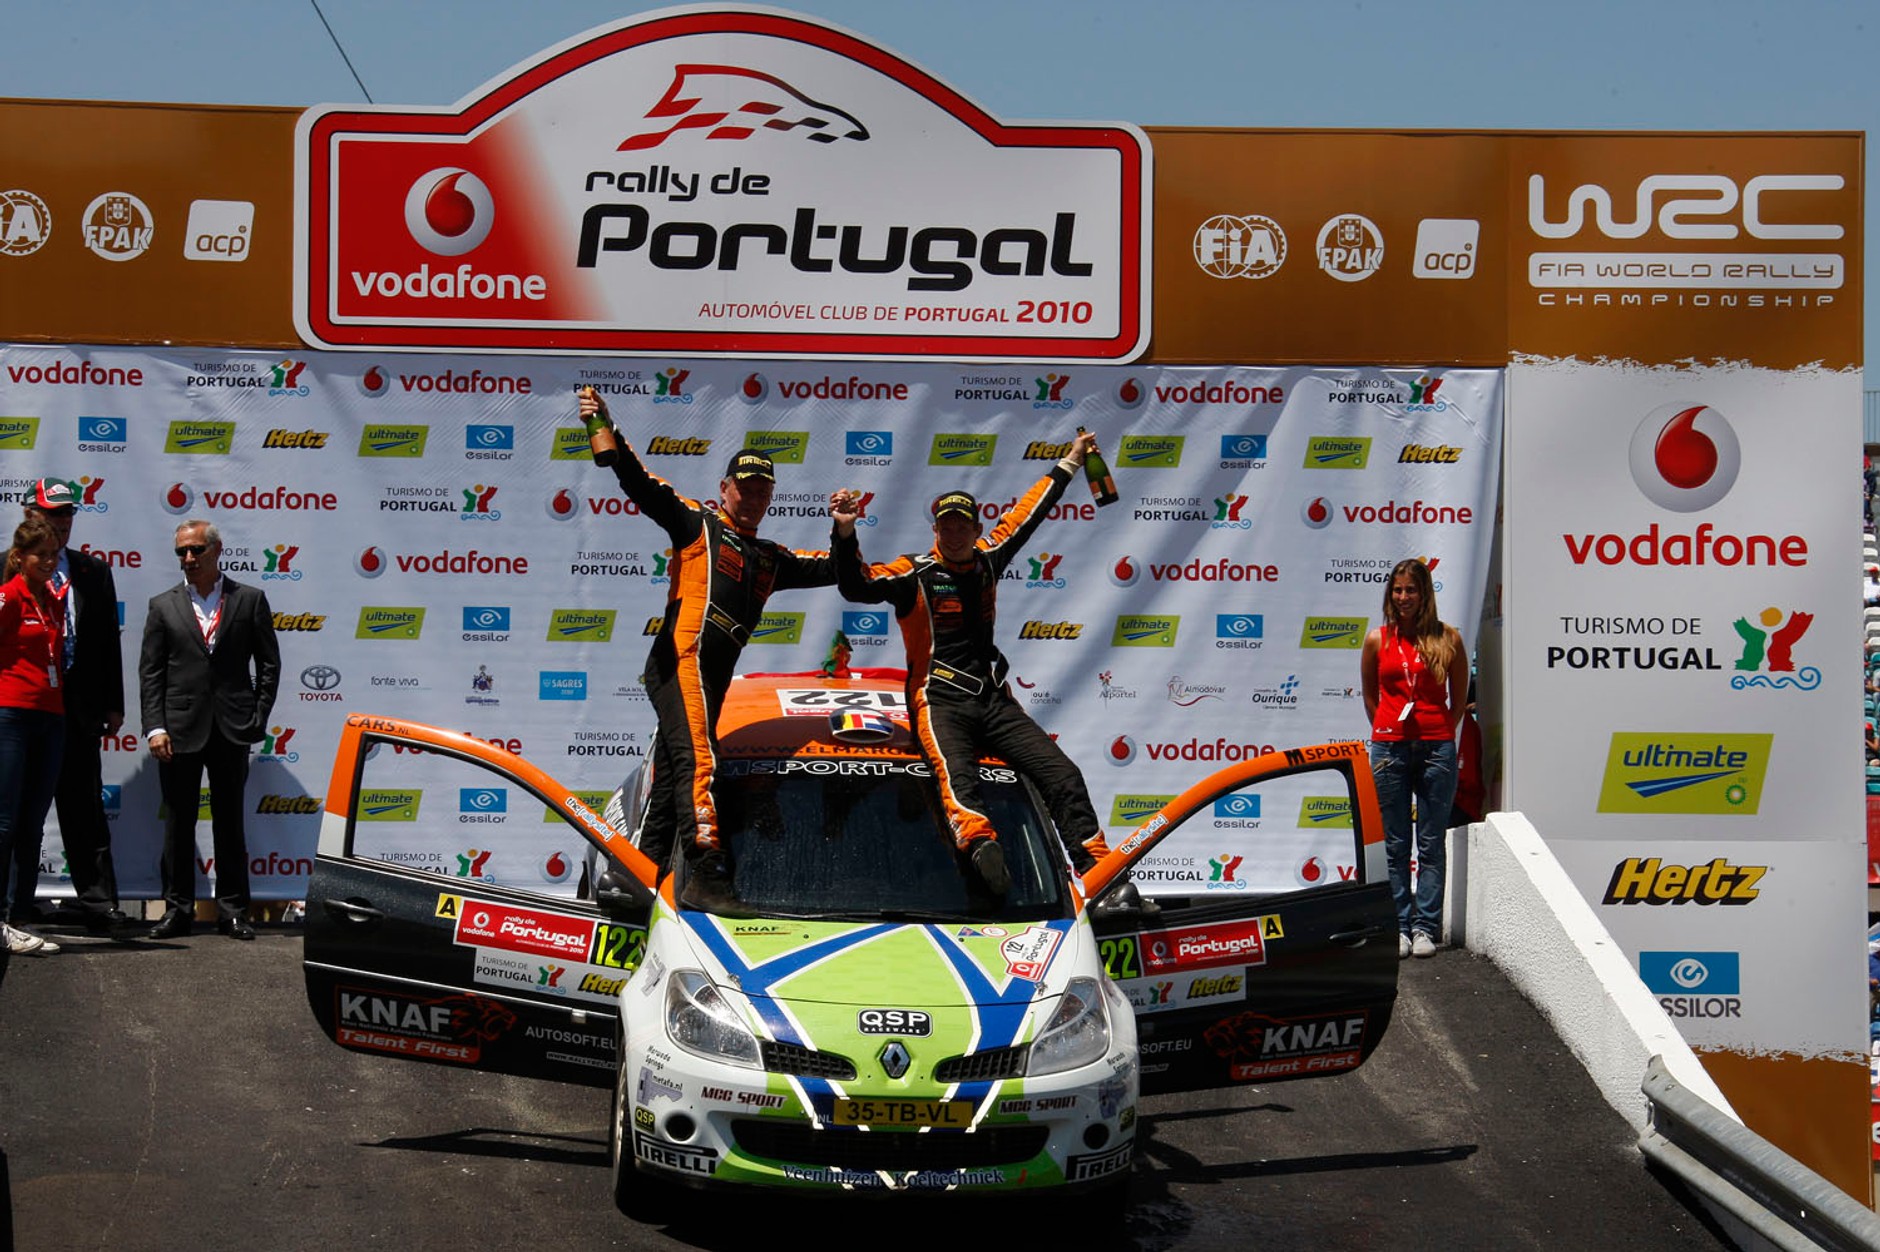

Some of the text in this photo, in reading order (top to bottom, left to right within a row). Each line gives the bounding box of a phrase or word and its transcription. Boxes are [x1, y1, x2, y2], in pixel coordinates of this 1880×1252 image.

[585, 165, 770, 202] rally de
[1529, 174, 1845, 239] WRC
[85, 225, 152, 250] FPAK
[196, 234, 246, 256] acp
[577, 203, 1093, 292] Portugal
[1319, 247, 1382, 270] FPAK
[1424, 253, 1472, 274] acp
[1539, 264, 1834, 278] FIA WORLD RALLY
[352, 264, 547, 300] vodafone
[1539, 294, 1834, 306] CHAMPIONSHIP
[699, 300, 1093, 324] AUTOMÓVEL CLUB DE PORTUGAL 2010
[8, 361, 143, 386] vodafone
[194, 363, 257, 374] TURISMO DE
[580, 370, 642, 380] TURISMO DE
[187, 376, 265, 388] PORTUGAL
[400, 370, 532, 394] vodafone
[962, 377, 1022, 386] TURISMO DE
[1335, 380, 1395, 389] TURISMO DE
[779, 376, 908, 400] vodafone
[1156, 381, 1283, 404] vodafone
[955, 389, 1030, 400] PORTUGAL
[1329, 392, 1404, 404] PORTUGAL
[175, 425, 226, 436] ultimate
[368, 429, 419, 440] ultimate
[262, 428, 329, 449] Hertz
[750, 436, 800, 446] ultimate
[938, 438, 988, 449] ultimate
[78, 443, 127, 453] essilor
[647, 436, 712, 456] Hertz
[1022, 440, 1072, 460] Hert
[1126, 440, 1176, 450] ultimate
[1313, 441, 1363, 451] ultimate
[465, 451, 513, 461] essilor
[1398, 444, 1464, 463] Hertz
[845, 457, 892, 466] essilor
[1220, 461, 1267, 470] essilor
[204, 486, 337, 510] vodafone
[386, 488, 449, 497] TURISMO DE
[813, 494, 826, 503] DE
[380, 501, 457, 512] PORTUGAL
[1141, 497, 1201, 506] TURISMO DE
[1134, 510, 1209, 521] PORTUGAL
[1343, 501, 1472, 523] vodafone
[1563, 523, 1808, 567] vodafone
[396, 550, 528, 574] vodafone
[577, 552, 639, 561] TURISMO DE
[571, 564, 647, 576] PORTUGAL
[1331, 559, 1392, 569] TURISMO DE
[1150, 559, 1279, 582] vodafone
[1325, 572, 1391, 583] PORTUGA
[366, 611, 416, 622] ultimate
[557, 614, 606, 625] ultimate
[1121, 619, 1171, 629] ultimate
[1309, 622, 1359, 632] ultimate
[1560, 617, 1701, 635] TURISMO DE
[1019, 621, 1083, 640] Hertz
[462, 632, 510, 642] essilor
[850, 636, 888, 646] ssilor
[1216, 640, 1262, 649] essilor
[1548, 646, 1722, 670] PORTUGAL
[371, 676, 419, 686] fonte viva
[551, 679, 583, 689] SAGRES
[299, 692, 343, 702] TOYOTA
[1252, 693, 1297, 705] Ourique
[574, 732, 635, 742] TURISMO DE
[568, 745, 644, 756] PORTUGAL
[1623, 744, 1747, 768] ultimate
[362, 793, 413, 804] ultimate
[256, 795, 323, 815] Hertz
[459, 815, 507, 824] essilor
[1214, 820, 1261, 829] essilor
[381, 853, 442, 863] TURISMO DE
[1182, 858, 1194, 866] DE
[1129, 870, 1203, 882] PORTUGAL
[1602, 858, 1768, 906] Hertz
[439, 897, 456, 917] A
[504, 915, 536, 926] rally de
[462, 926, 496, 939] vodafone
[1264, 917, 1281, 937] A
[500, 922, 587, 947] Portugal
[1178, 935, 1197, 944] rally
[1179, 935, 1258, 957] Portugal
[481, 956, 528, 971] TURISMO DE
[476, 966, 534, 984] PORTUGAL
[1187, 974, 1244, 999] Hertz
[341, 993, 451, 1034] KNAF
[1660, 998, 1741, 1018] SSILOR
[861, 1011, 927, 1027] QSP
[1262, 1018, 1364, 1053] KNAF
[341, 1029, 410, 1051] Talent
[415, 1040, 470, 1059] First
[1240, 1054, 1355, 1077] Talent First
[737, 1091, 787, 1109] SPORT
[1036, 1095, 1079, 1111] SPORT
[636, 1110, 655, 1125] QSP
[818, 1114, 833, 1123] NL
[847, 1102, 957, 1123] 35-TB-VL
[634, 1130, 718, 1174] PIRELLI
[782, 1164, 1004, 1187] Veenhuizen Koeltechniek
